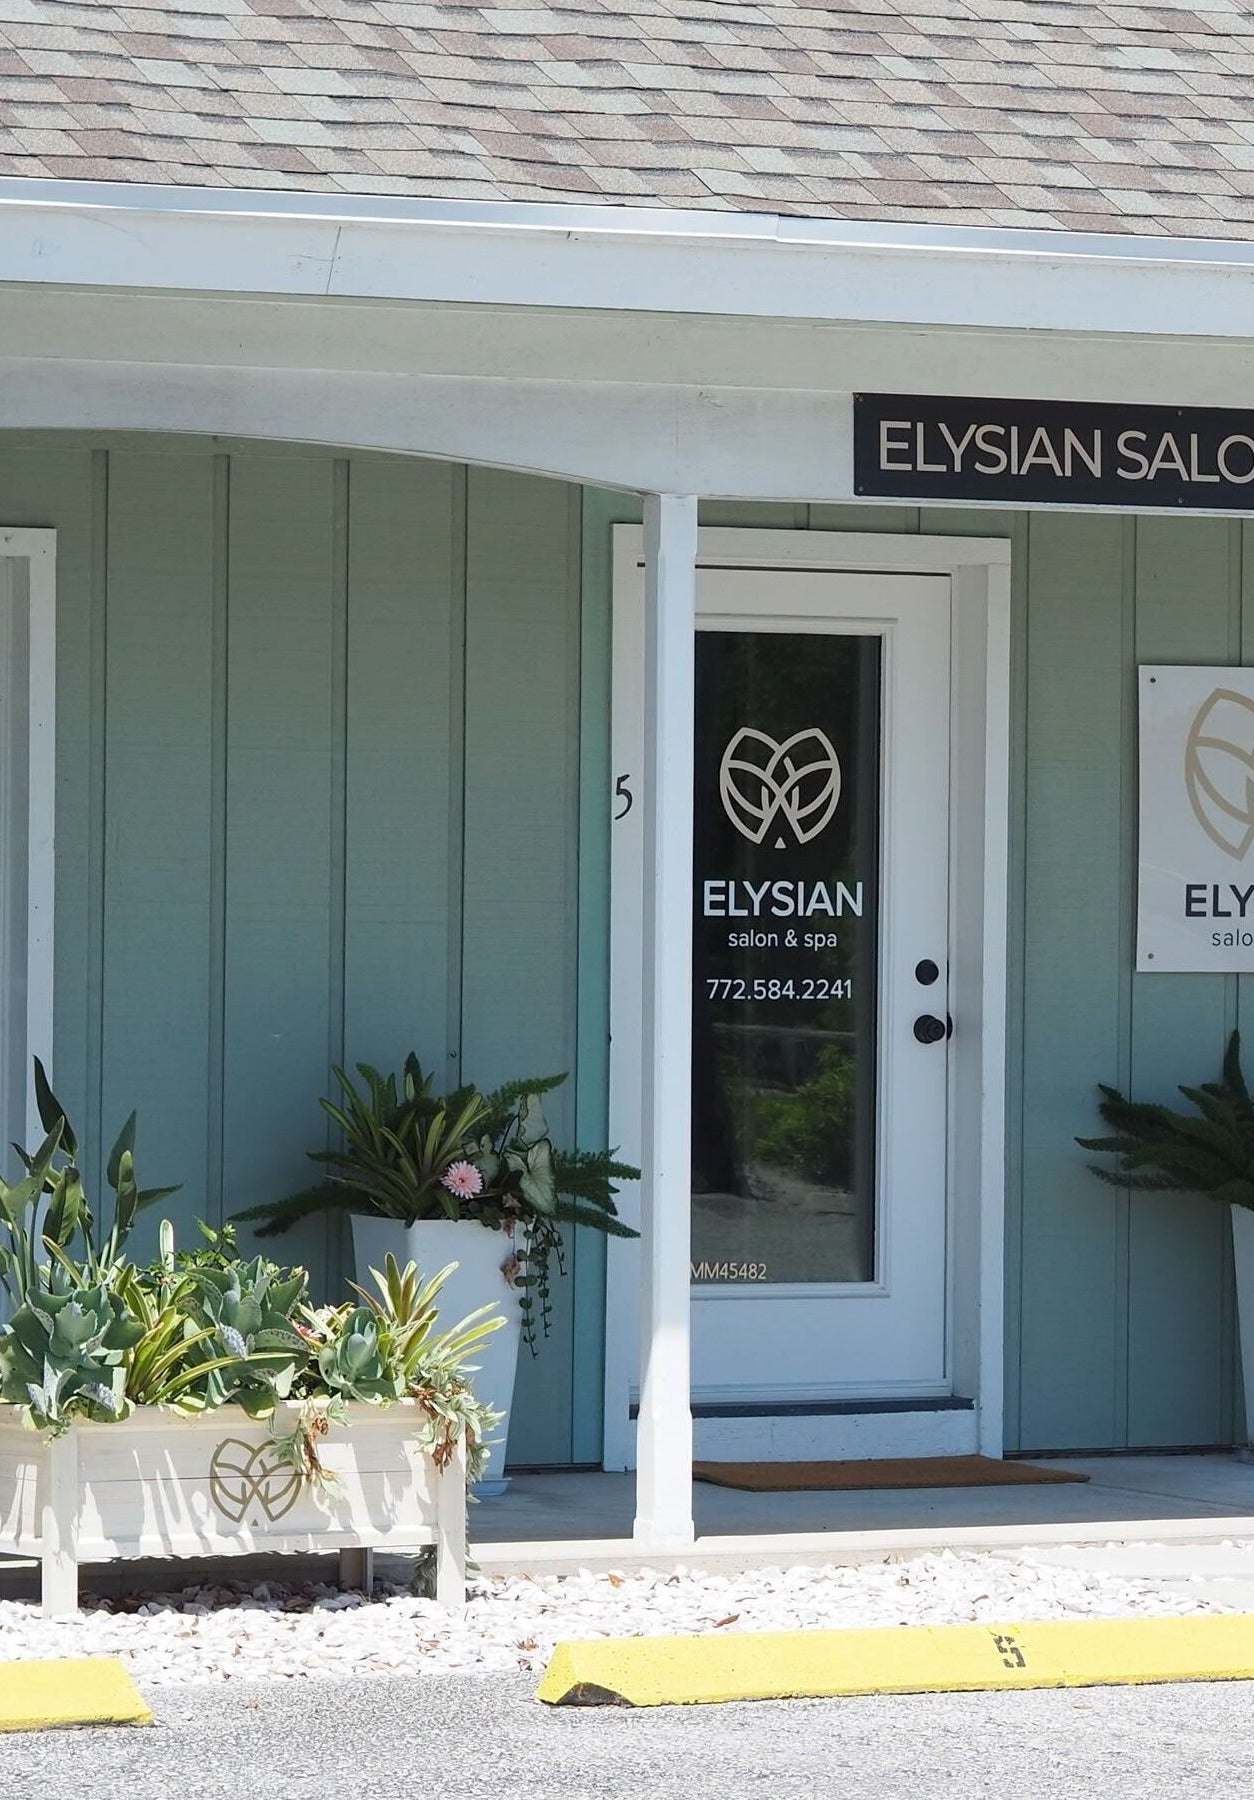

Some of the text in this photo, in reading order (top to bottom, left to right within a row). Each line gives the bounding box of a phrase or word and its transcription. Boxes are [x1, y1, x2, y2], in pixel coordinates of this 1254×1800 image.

[878, 419, 1101, 478] ELYSIAN
[614, 774, 633, 820] 5
[703, 880, 863, 917] ELYSIAN
[728, 929, 837, 951] salon & spa
[706, 978, 852, 1000] 772.584.2241
[993, 1635, 1026, 1668] 5
